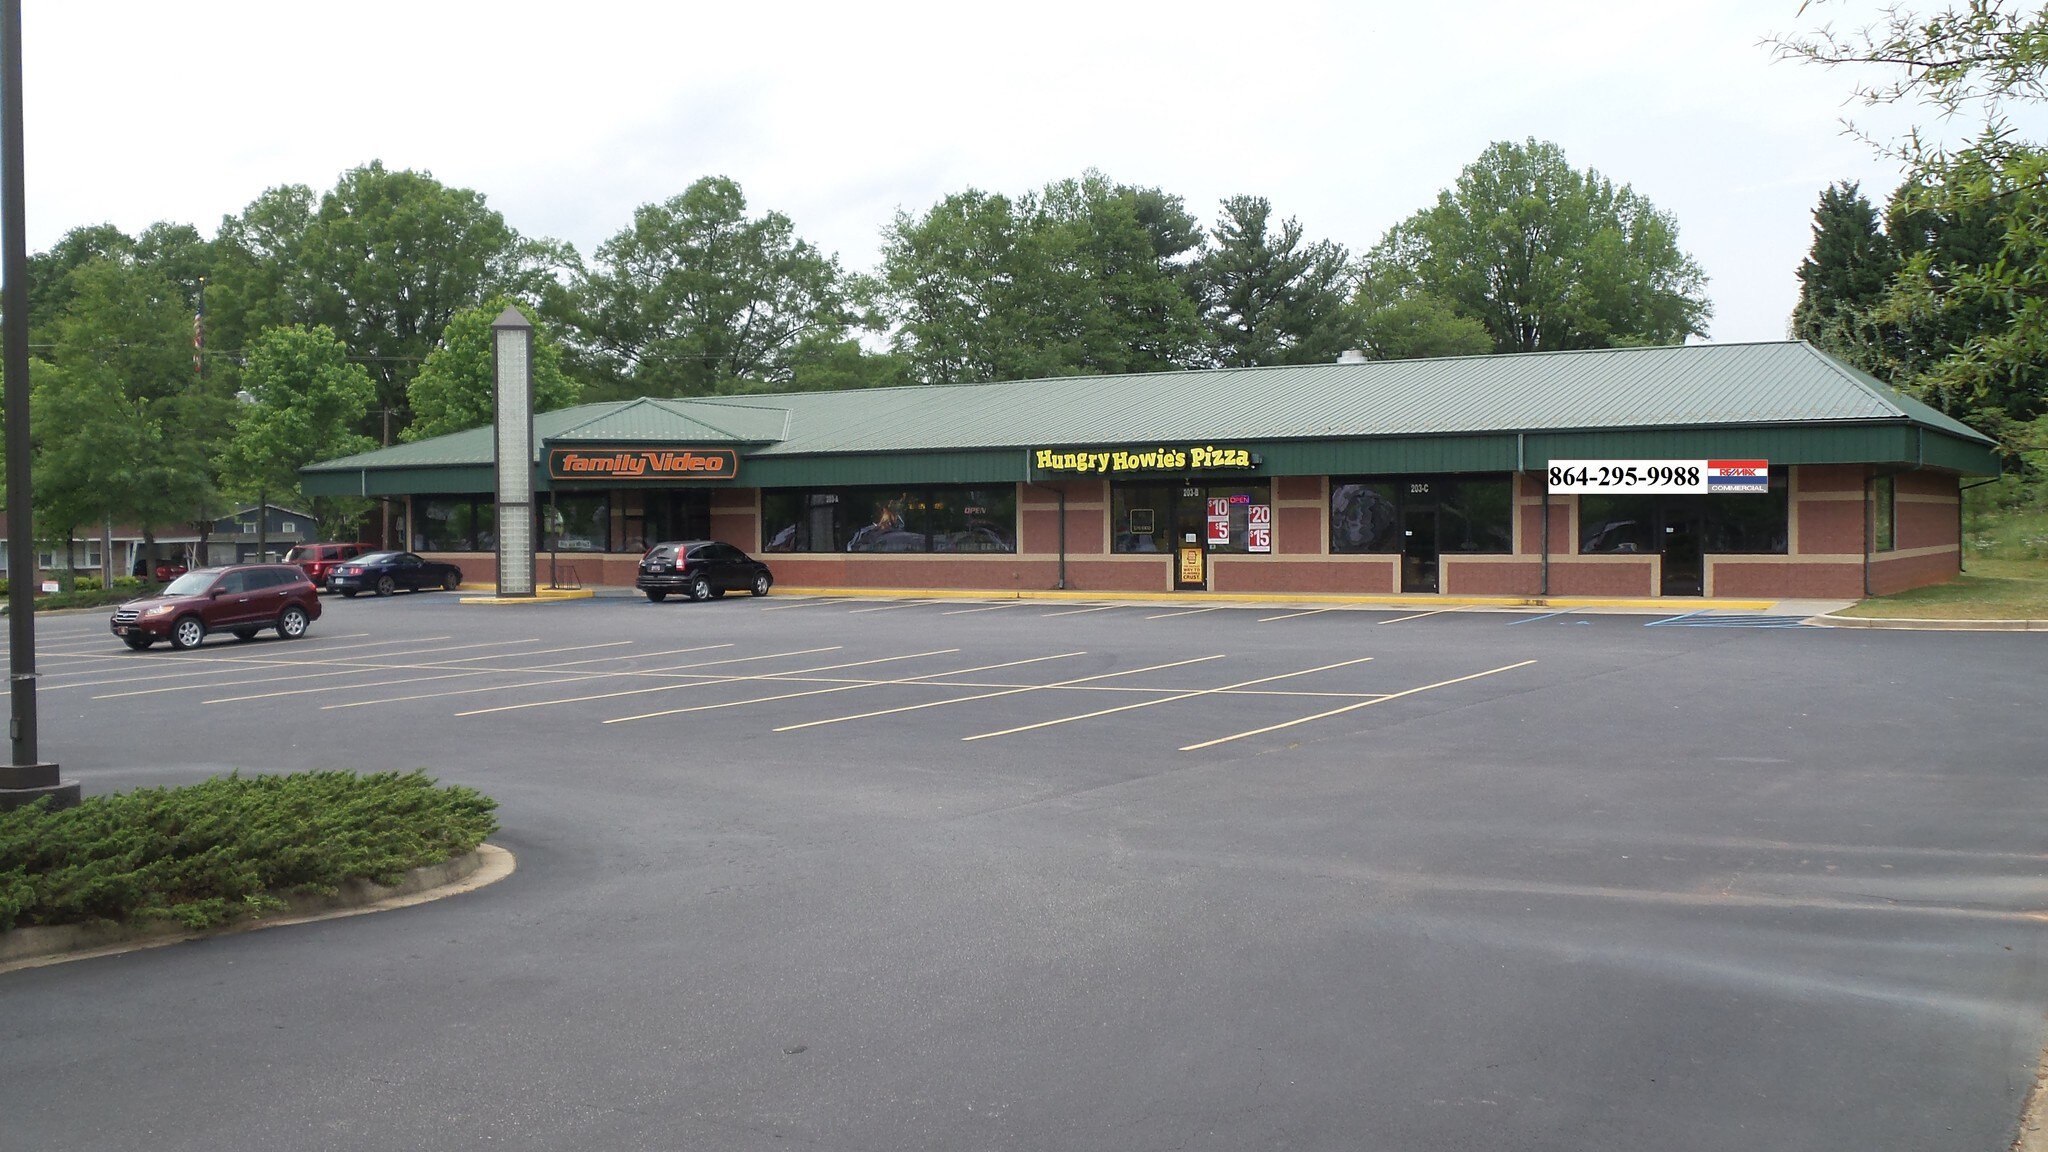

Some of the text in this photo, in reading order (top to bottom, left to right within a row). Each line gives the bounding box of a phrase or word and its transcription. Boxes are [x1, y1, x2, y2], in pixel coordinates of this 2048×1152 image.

[562, 453, 724, 475] family Video
[1036, 445, 1250, 472] Hungry Howie's Pizza
[1410, 483, 1429, 493] 203-C
[1208, 499, 1228, 516] $10
[1229, 496, 1249, 504] OPEN
[964, 506, 987, 514] OPEN
[1248, 506, 1271, 523] $20
[1215, 522, 1228, 539] $5
[1249, 529, 1270, 546] $15
